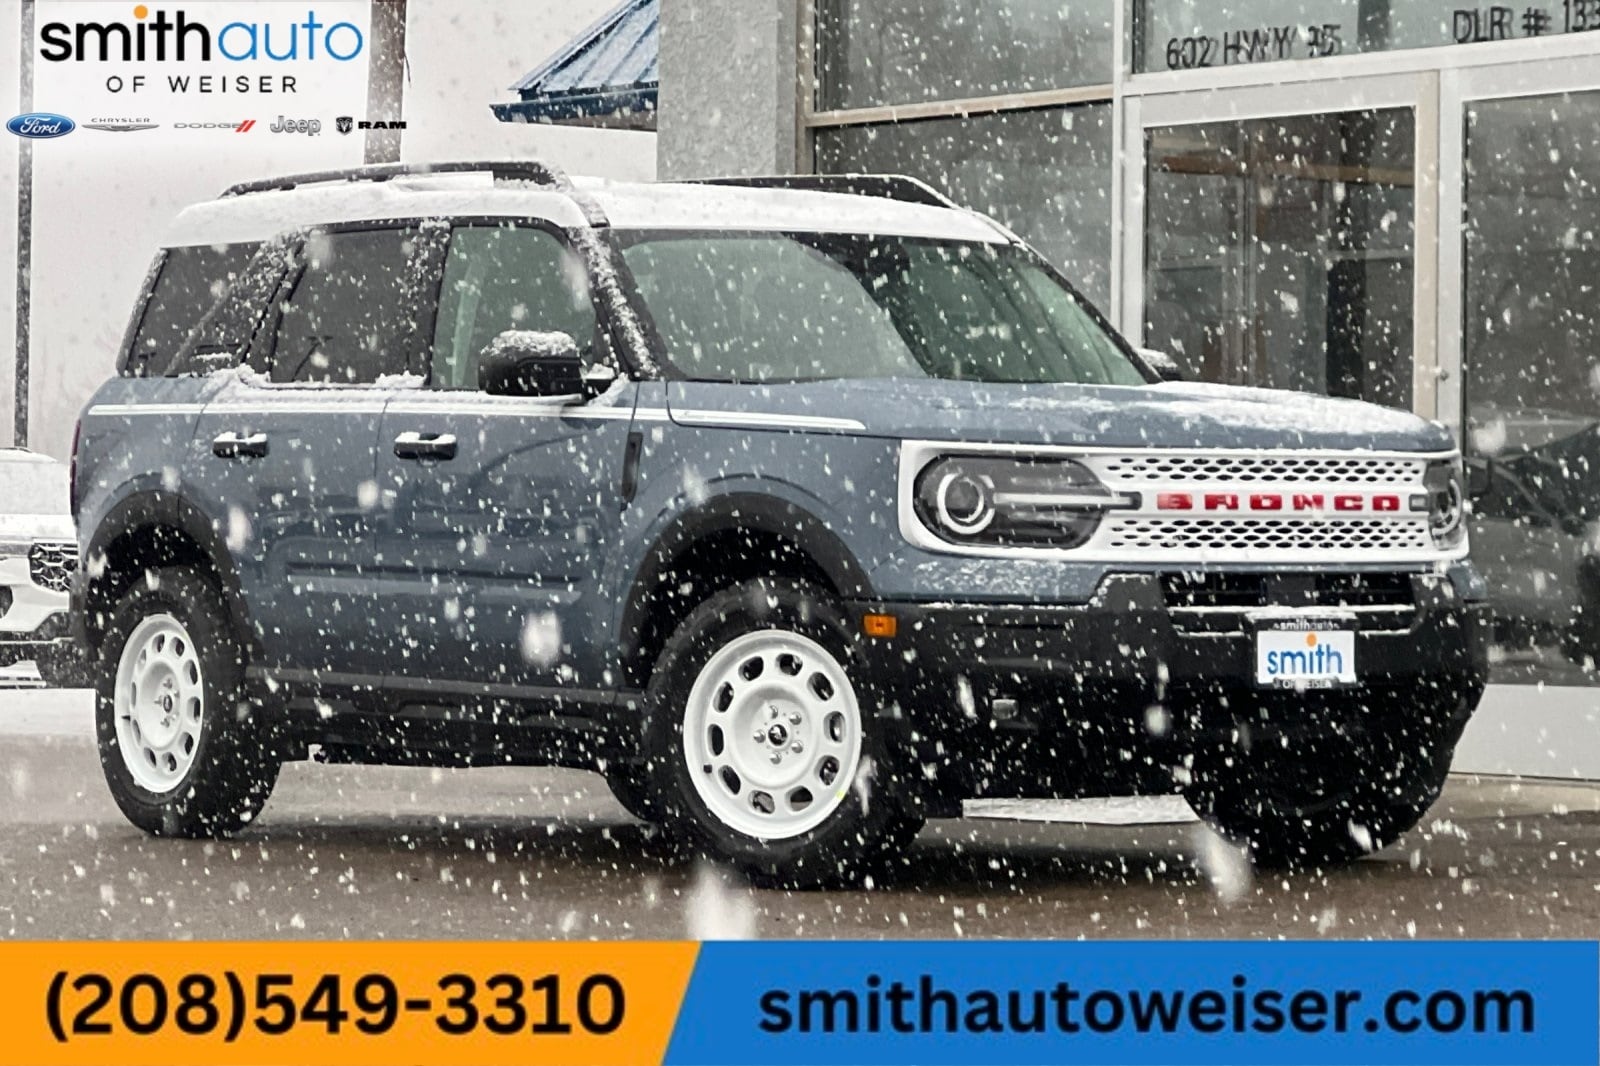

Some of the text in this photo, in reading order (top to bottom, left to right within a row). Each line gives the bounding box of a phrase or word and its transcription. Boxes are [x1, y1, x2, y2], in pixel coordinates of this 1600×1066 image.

[1452, 6, 1512, 44] DLR
[1521, 7, 1546, 37] #
[1166, 35, 1215, 70] 602
[1224, 25, 1293, 65] HWY
[1156, 493, 1401, 512] BRONCO
[1267, 632, 1343, 674] smith
